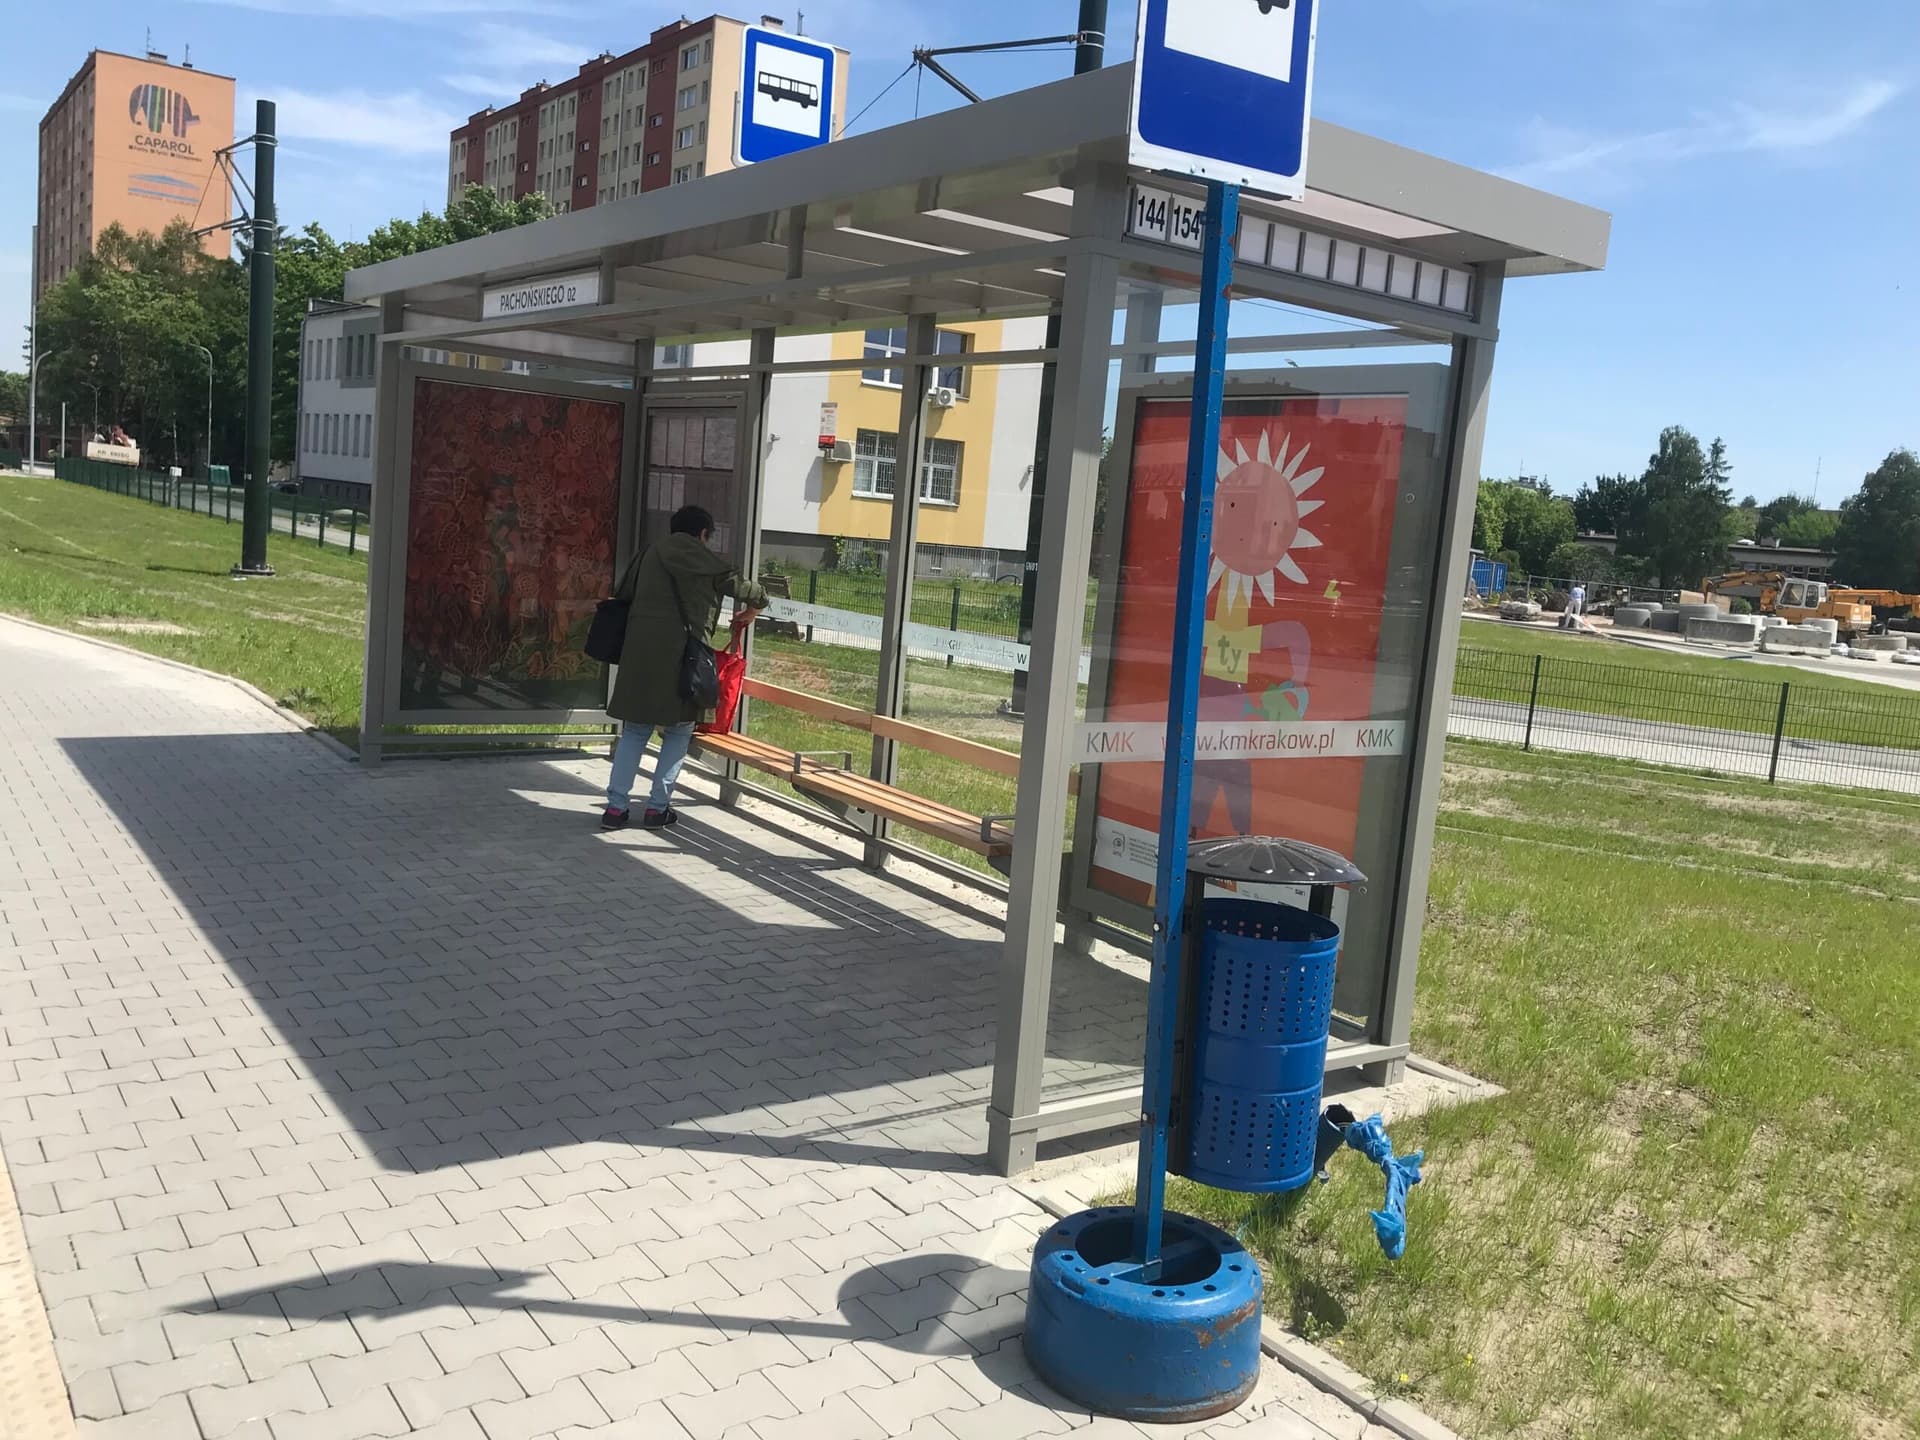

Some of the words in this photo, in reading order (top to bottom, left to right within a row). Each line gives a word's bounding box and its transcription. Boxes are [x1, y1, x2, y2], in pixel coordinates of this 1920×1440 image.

[135, 134, 195, 156] CAPAROL
[1137, 195, 1166, 232] 144
[1173, 205, 1200, 241] 154
[499, 284, 565, 312] PACHOŃSKIEGO
[567, 287, 576, 302] 02
[1217, 634, 1242, 674] ty
[1086, 731, 1135, 753] KMK
[1161, 728, 1336, 754] w.kmkrakow.pl
[1356, 729, 1395, 748] KMK
